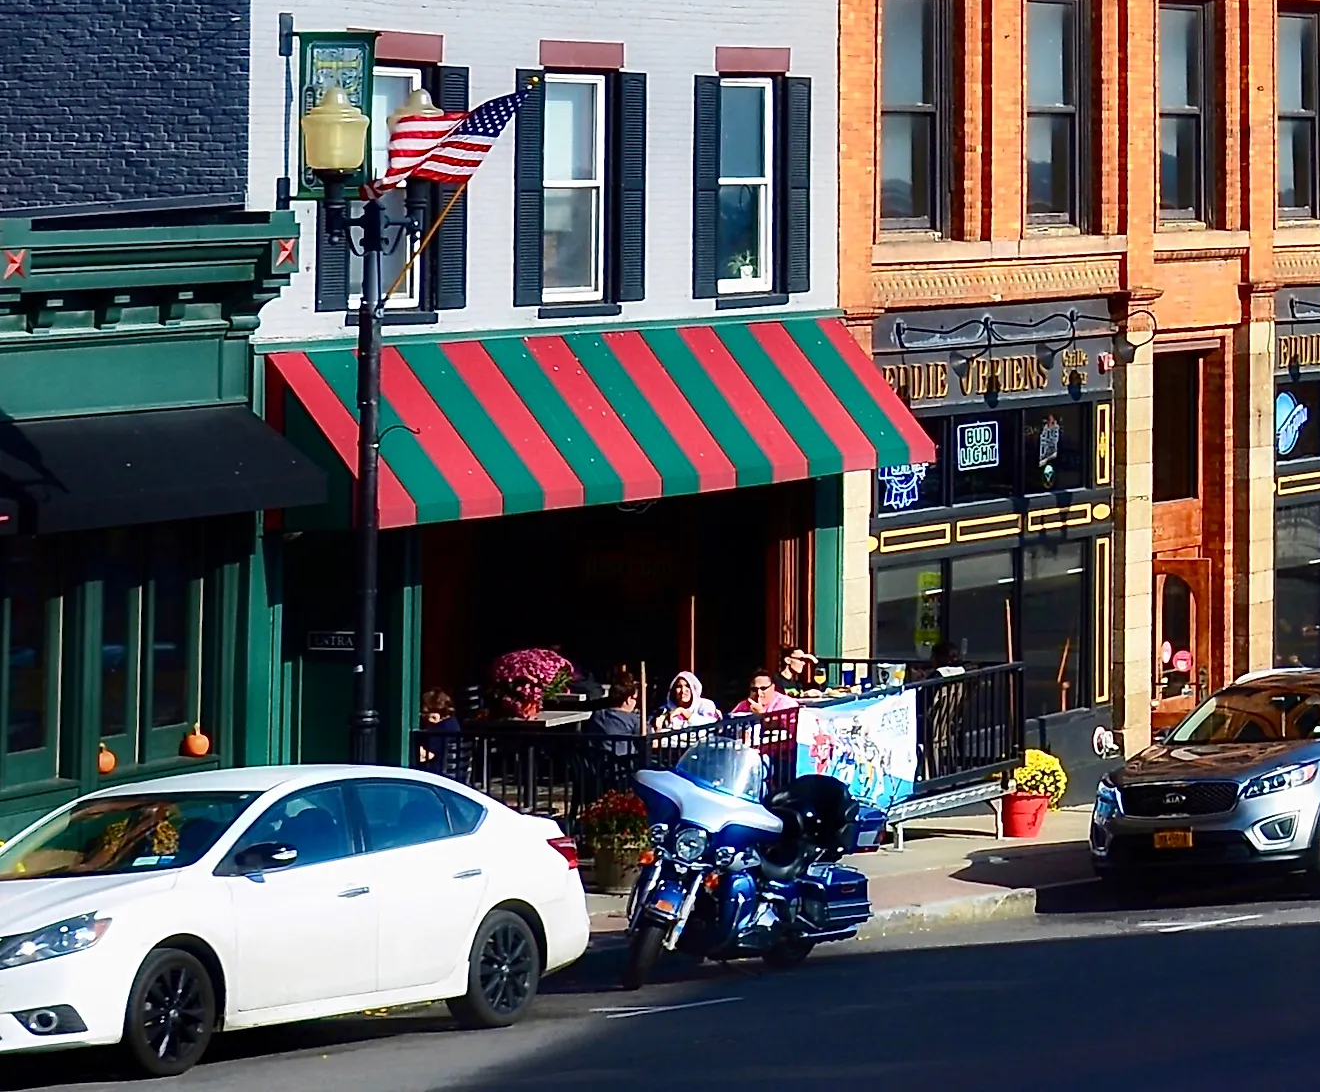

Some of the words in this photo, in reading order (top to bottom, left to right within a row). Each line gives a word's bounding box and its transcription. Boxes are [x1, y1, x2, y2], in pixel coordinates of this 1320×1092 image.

[882, 360, 949, 401] EDDIE
[965, 426, 992, 445] BUD
[960, 445, 998, 467] LIGHT
